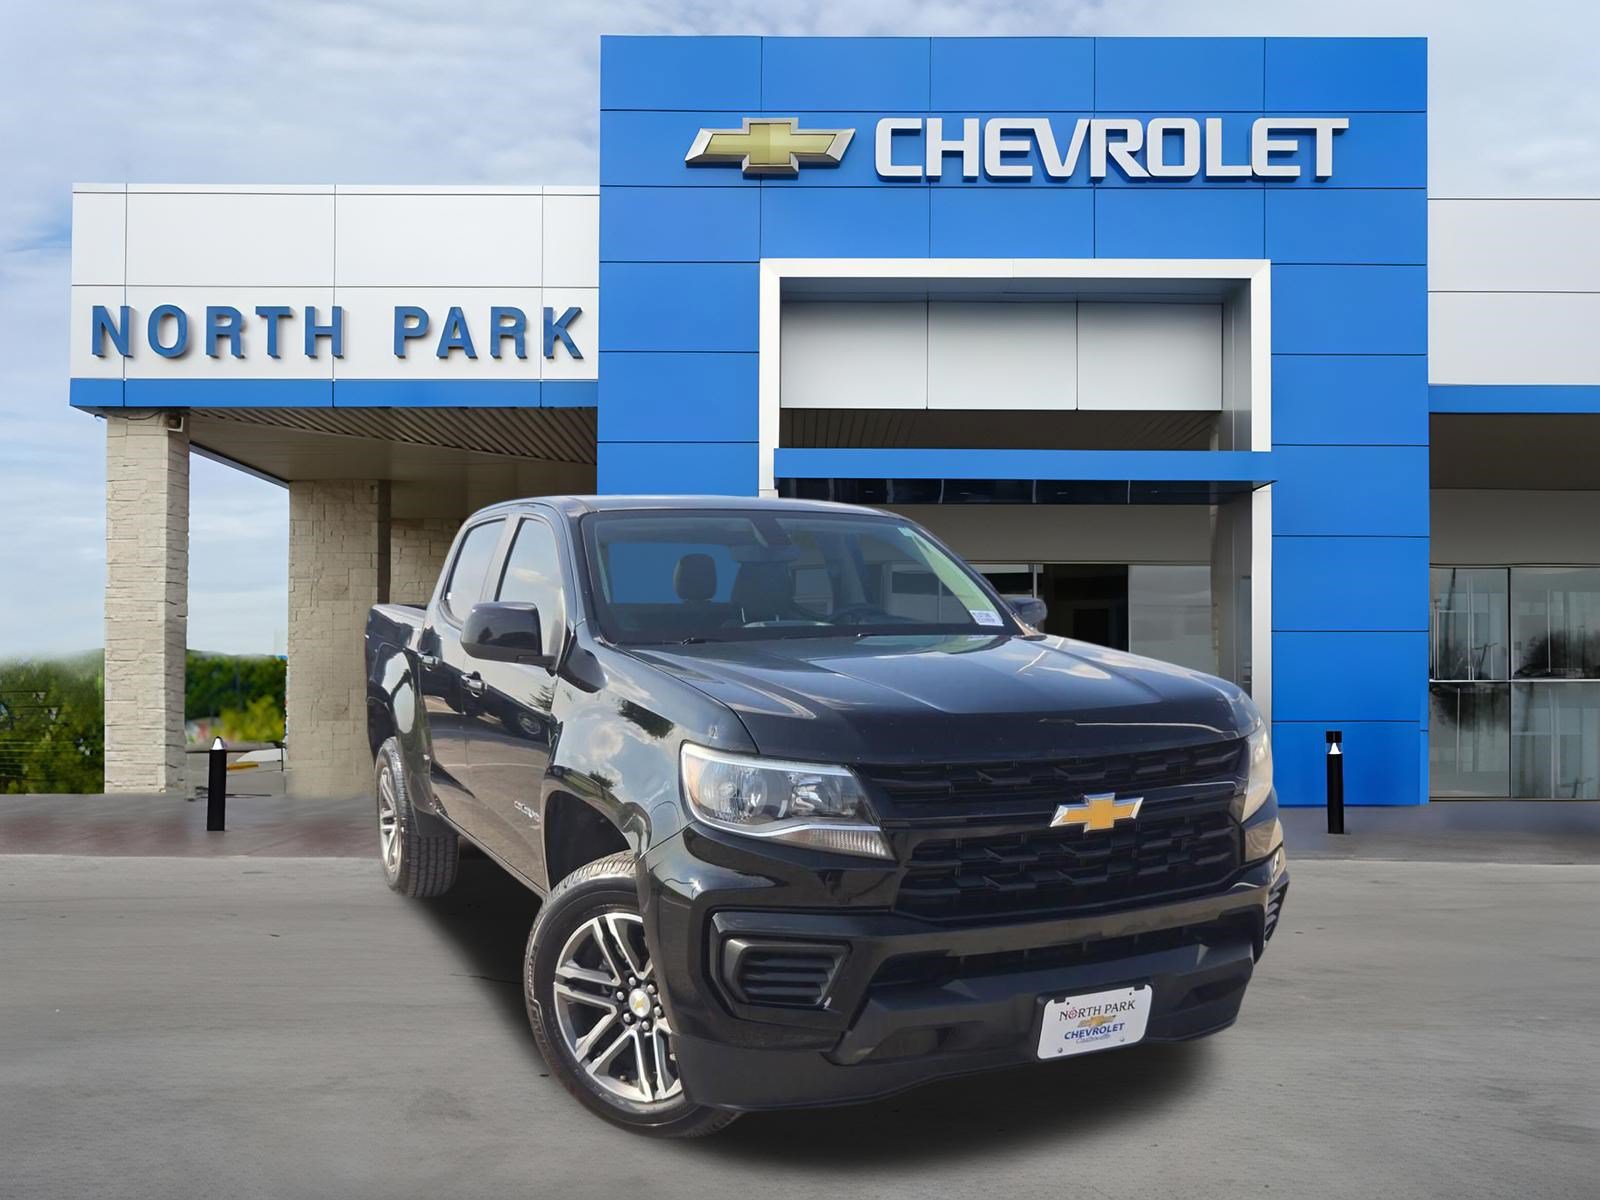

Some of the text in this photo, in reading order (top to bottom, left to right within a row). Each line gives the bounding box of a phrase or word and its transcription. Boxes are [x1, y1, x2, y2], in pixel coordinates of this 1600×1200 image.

[875, 117, 1350, 181] CHEVROLET
[91, 304, 585, 360] NORTH PARK
[1059, 1000, 1136, 1021] NORTH PARK
[1064, 1023, 1125, 1040] CHEVROLET
